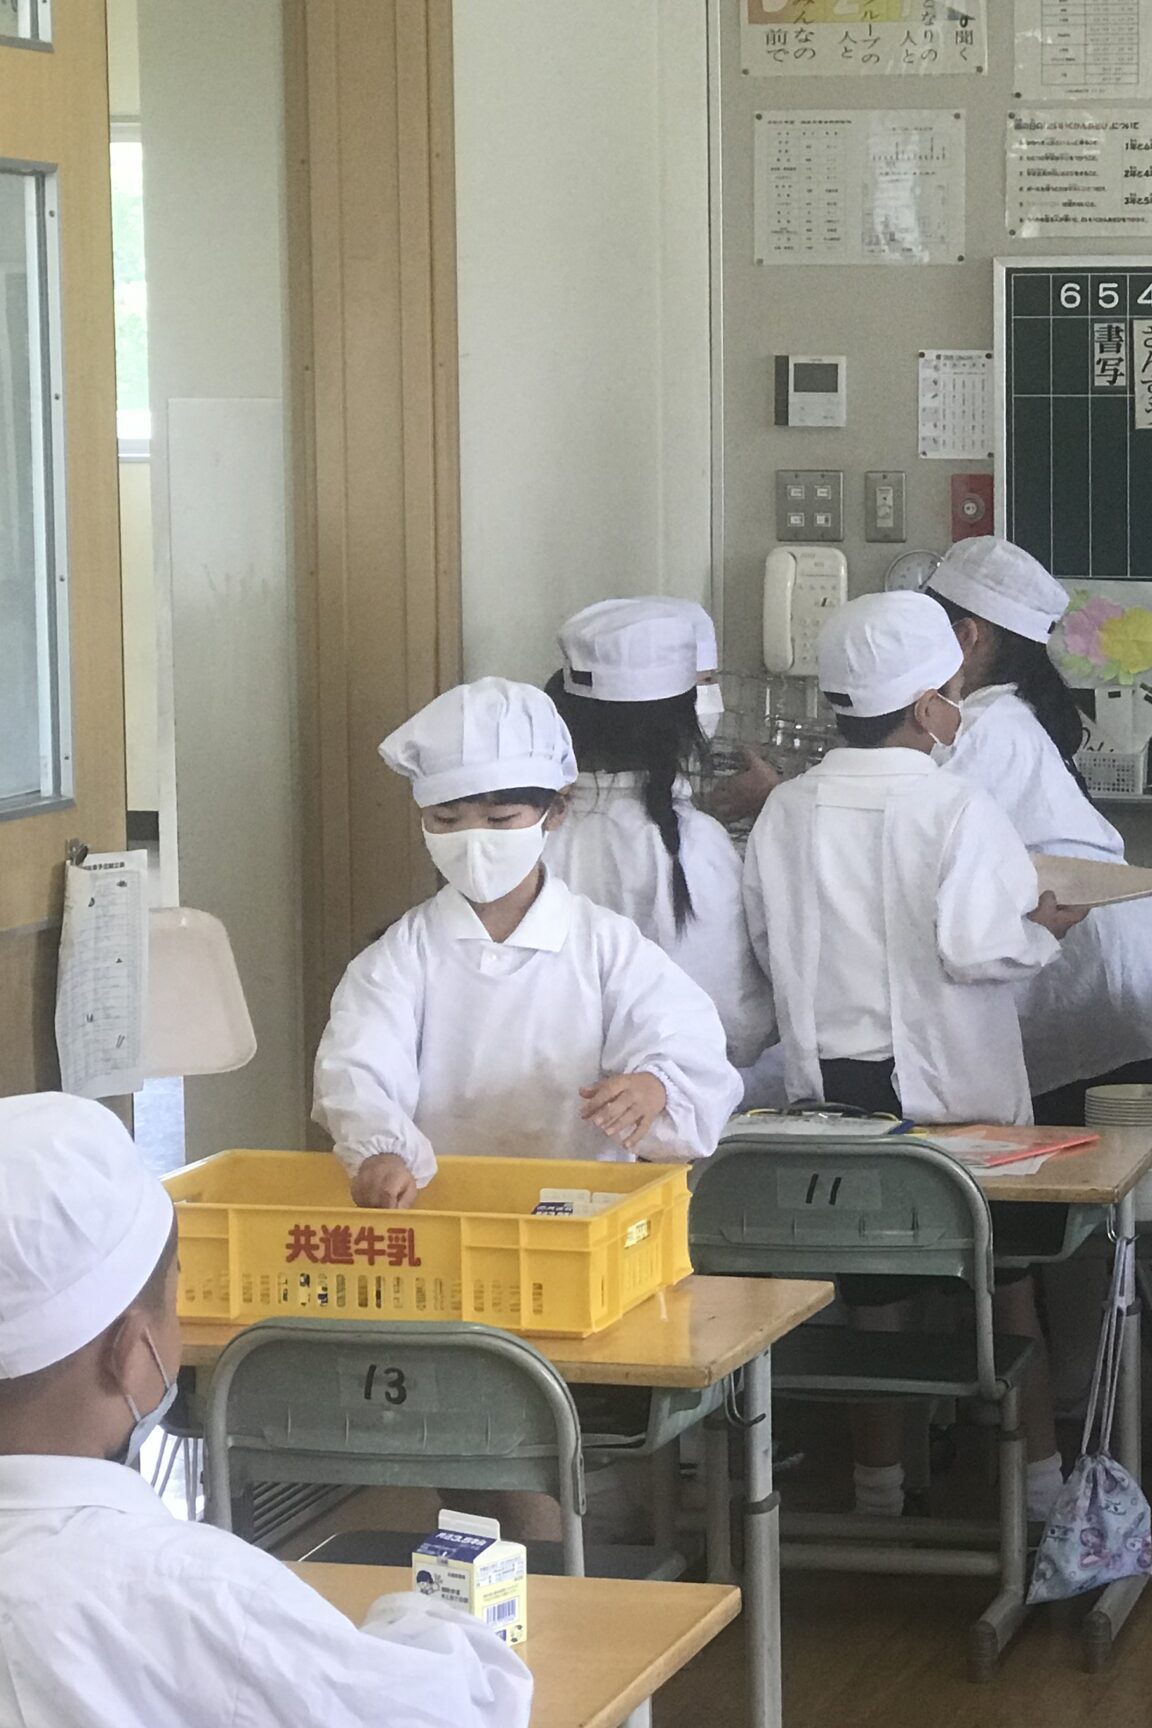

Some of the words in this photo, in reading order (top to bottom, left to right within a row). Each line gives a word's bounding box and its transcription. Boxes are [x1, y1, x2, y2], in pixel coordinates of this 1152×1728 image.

[765, 29, 790, 62] 前で
[838, 30, 858, 59] 人と
[900, 30, 917, 64] 人と
[955, 29, 973, 61] 聞く
[1060, 283, 1081, 307] 6
[1098, 283, 1119, 307] 5
[1095, 324, 1126, 386] 書写
[806, 1173, 842, 1206] 11
[285, 1223, 422, 1268] 共進牛乳
[363, 1363, 408, 1406] 13
